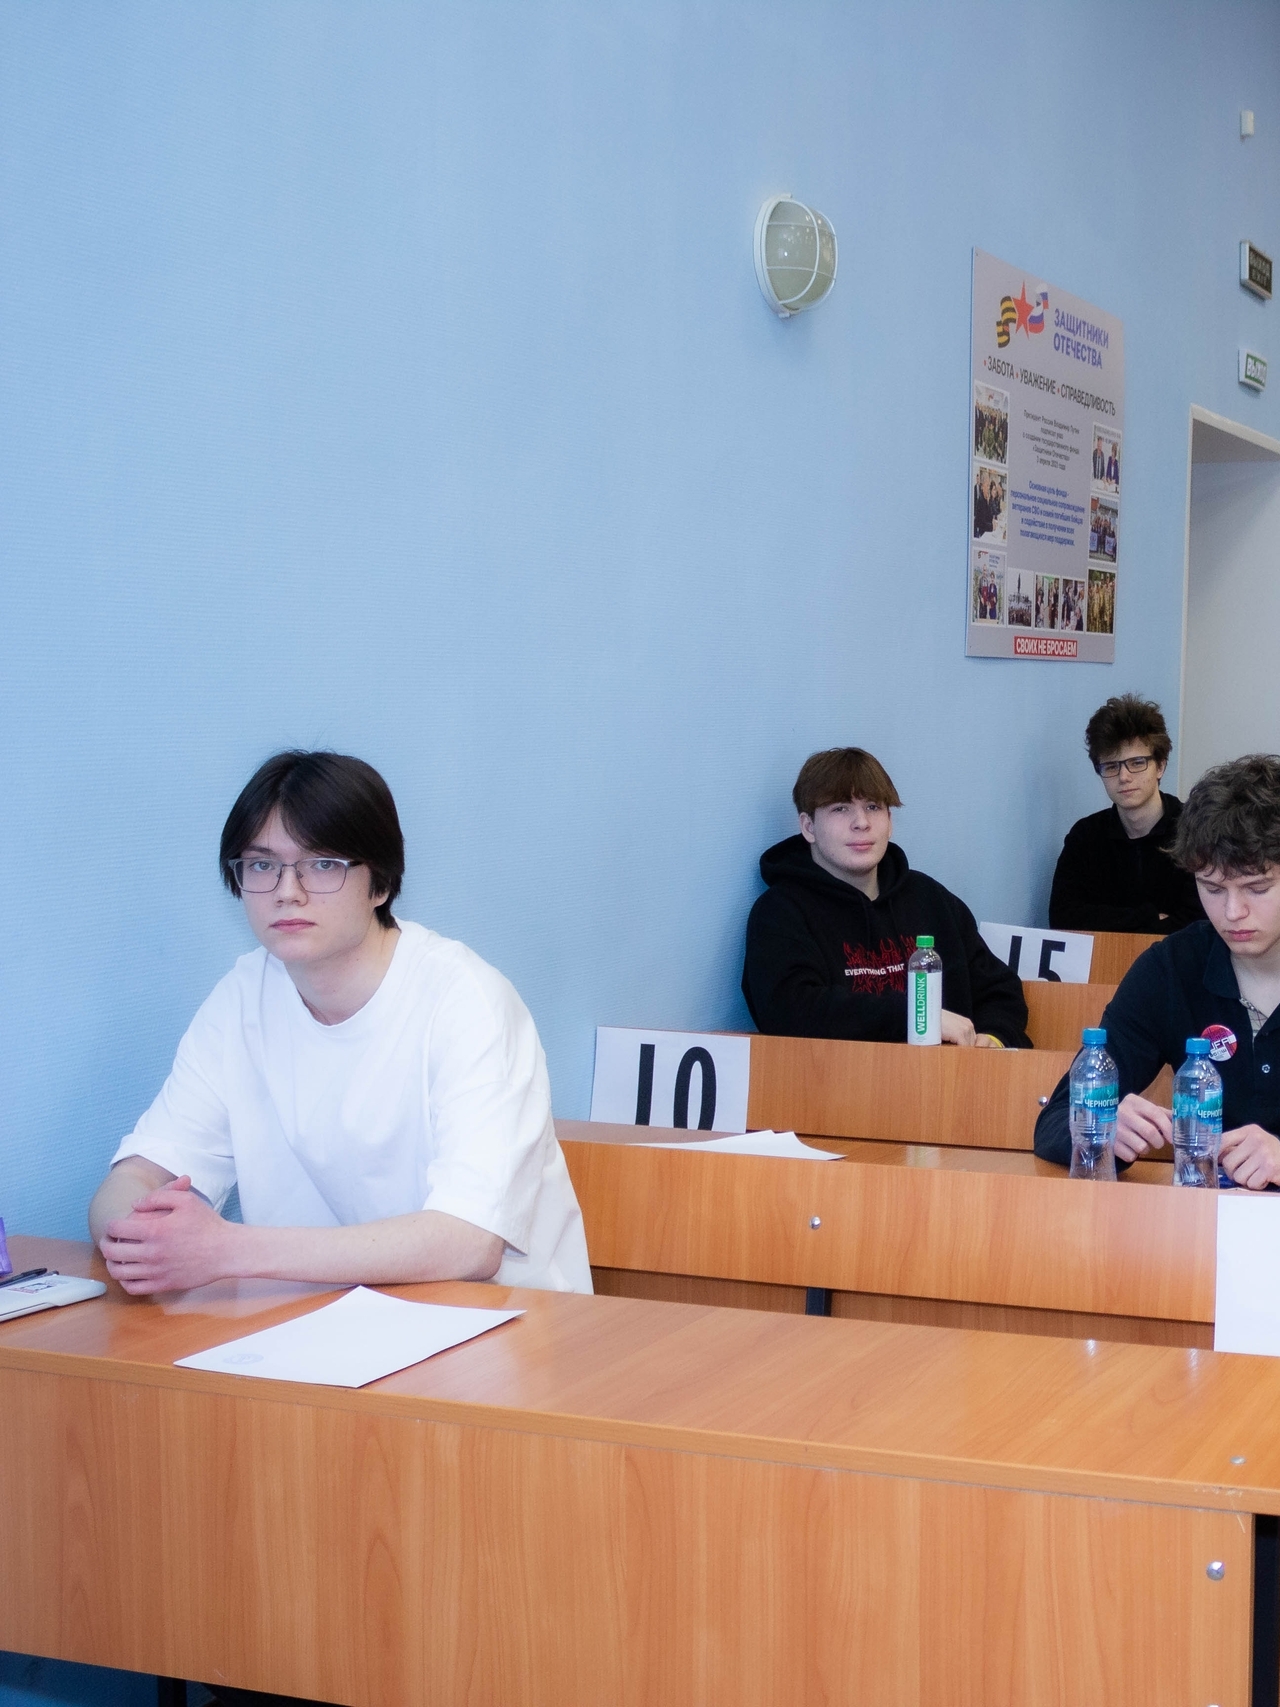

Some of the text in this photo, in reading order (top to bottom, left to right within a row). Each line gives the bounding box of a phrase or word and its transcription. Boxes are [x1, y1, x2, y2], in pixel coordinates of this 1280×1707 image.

[1054, 308, 1109, 348] ЗАЩИТНИКИ
[1053, 333, 1103, 369] ОТЕЧЕСТВА
[988, 356, 1116, 416] ЗАБОТА УВАЖЕНИЕ СПРАВЕДЛИВОСТЬ
[1016, 638, 1077, 656] СВОИХ НЕ БРОСАЕМ
[844, 963, 905, 977] EVERYTHING THAT
[916, 977, 926, 1032] WELLDRINK
[634, 1043, 717, 1131] 10
